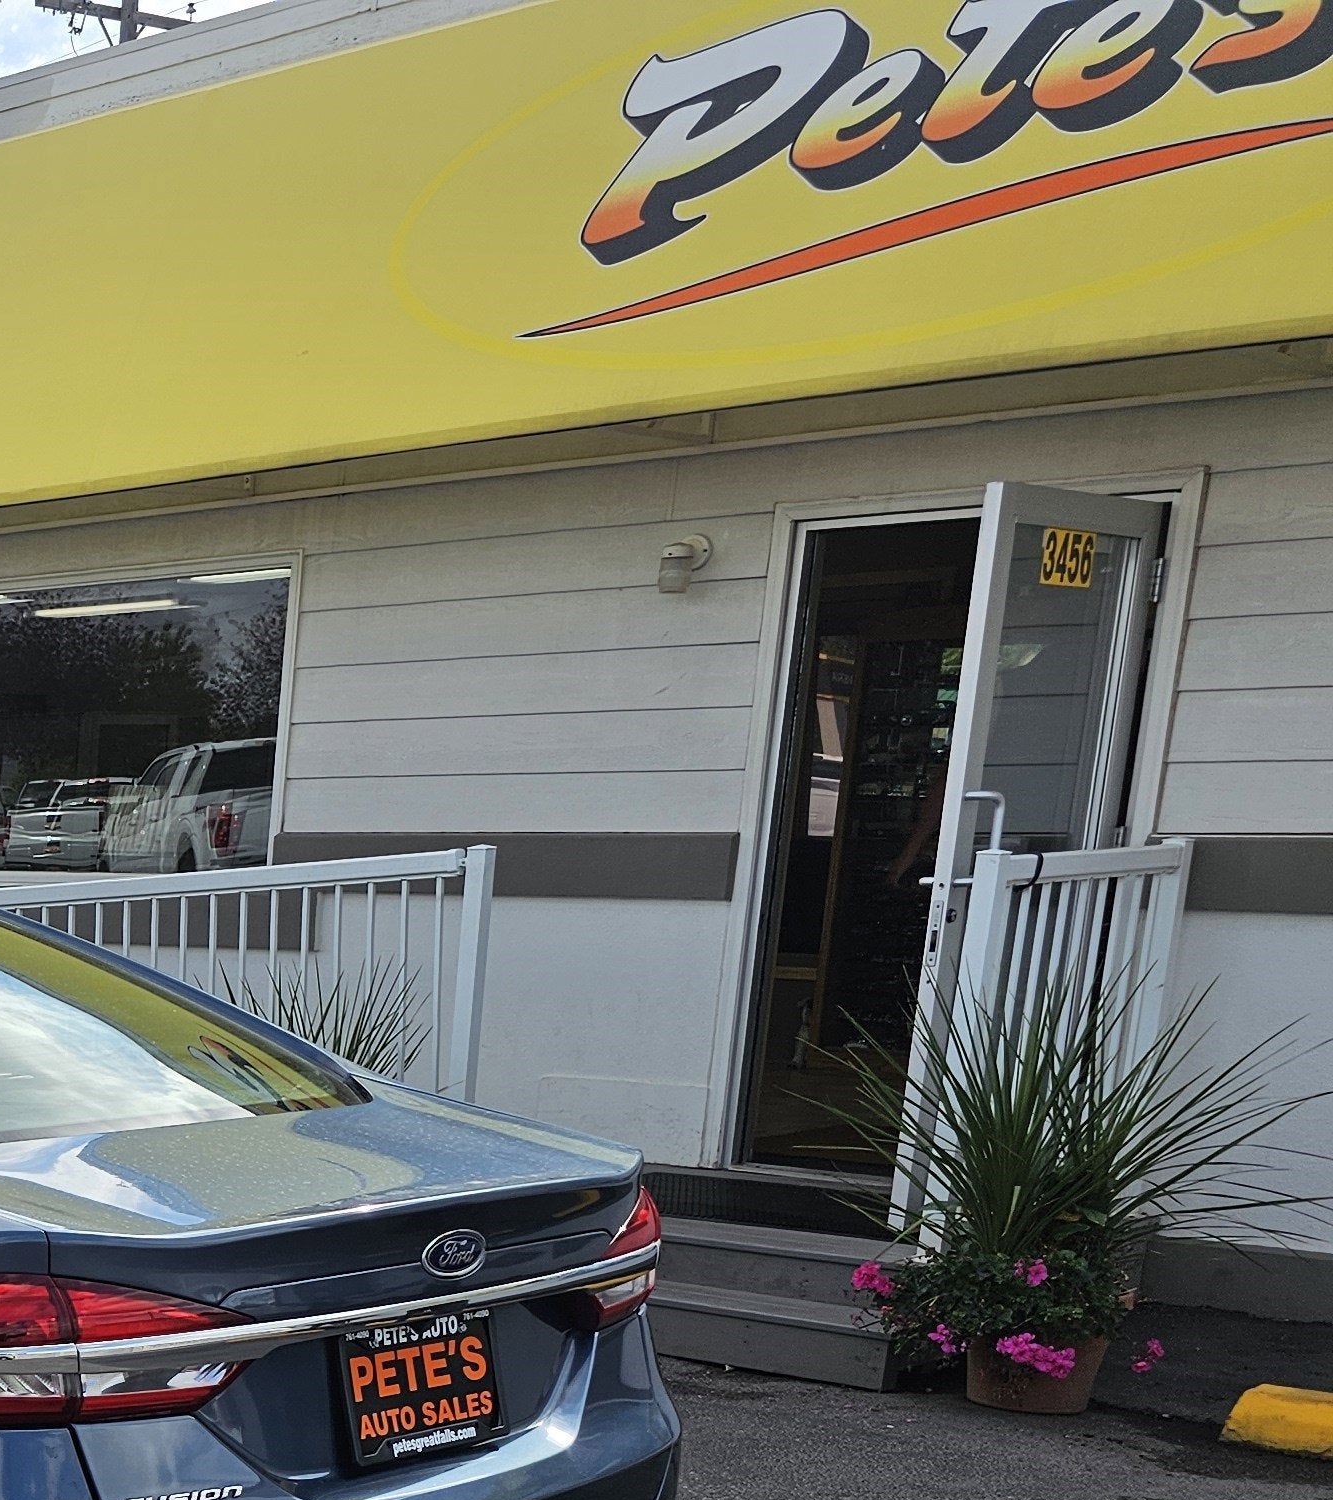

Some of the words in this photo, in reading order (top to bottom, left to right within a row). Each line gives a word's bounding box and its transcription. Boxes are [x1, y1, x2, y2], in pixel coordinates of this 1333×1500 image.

[581, 0, 1333, 266] Petes
[1042, 531, 1094, 584] 3456
[439, 1240, 476, 1267] Ford
[374, 1325, 419, 1347] PETE'S
[422, 1315, 458, 1339] AUTO
[463, 1309, 490, 1321] 761-4090
[349, 1335, 487, 1402] PETE'S
[360, 1405, 416, 1440] AUTO
[422, 1390, 493, 1426] SALES
[392, 1425, 477, 1457] petesgreatfalls.com
